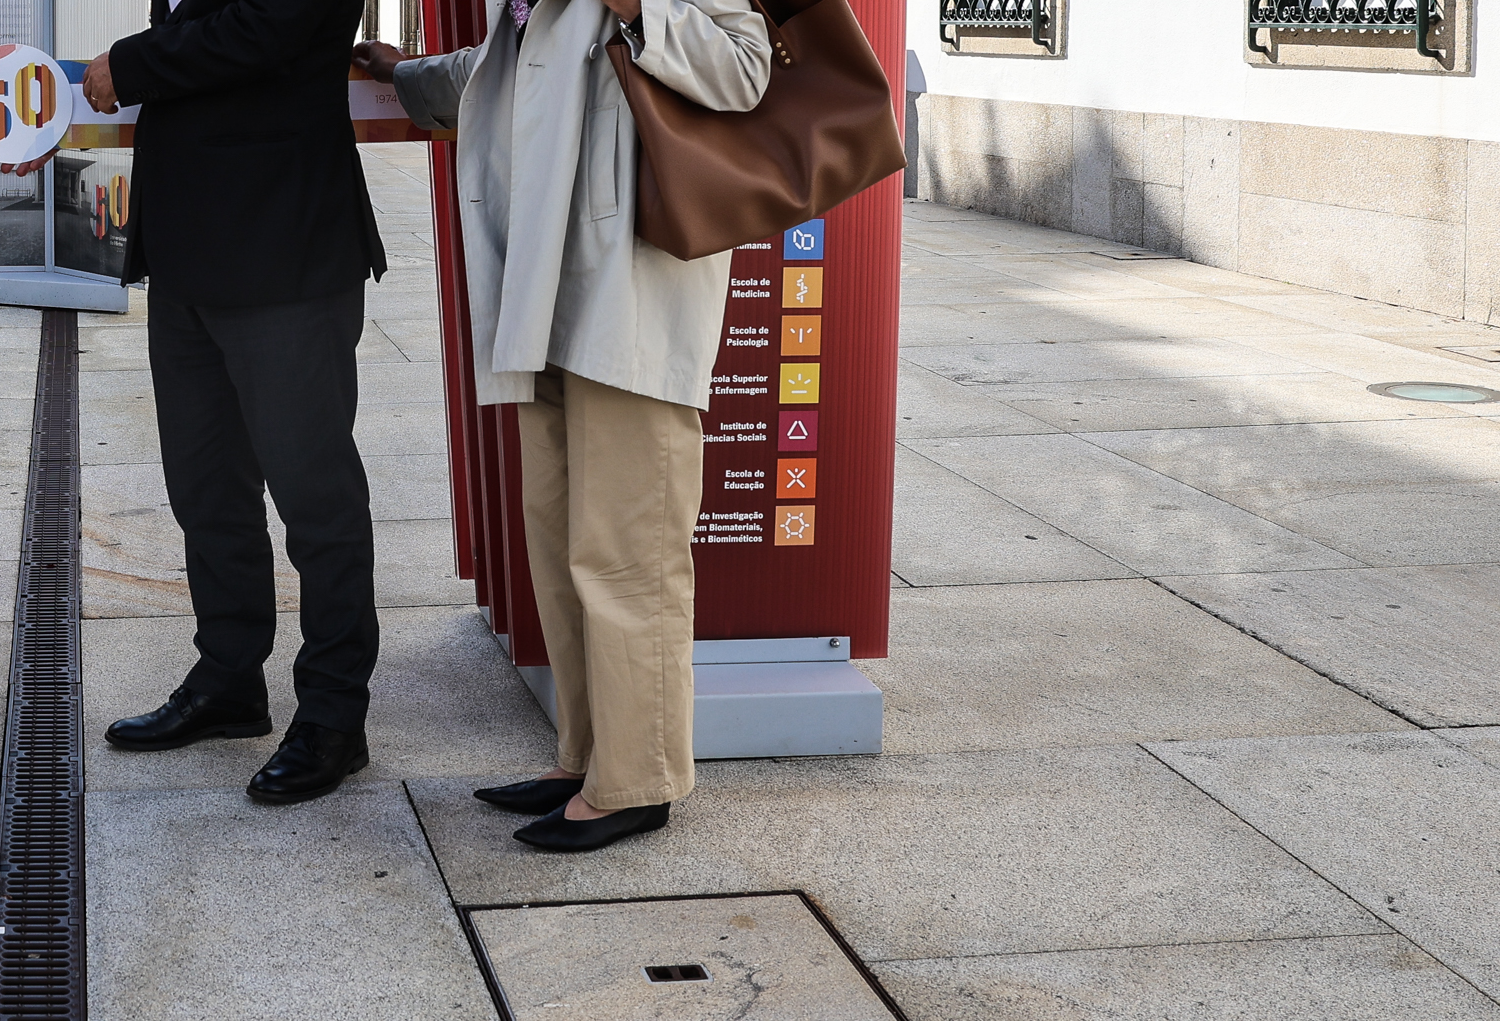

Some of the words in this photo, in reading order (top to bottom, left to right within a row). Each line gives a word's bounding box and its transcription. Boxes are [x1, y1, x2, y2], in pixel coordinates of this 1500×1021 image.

[375, 94, 398, 104] 1974
[730, 278, 758, 286] Escola
[760, 278, 771, 286] de
[732, 290, 770, 298] Medicina
[729, 326, 757, 335] Escola
[758, 326, 769, 335] de
[726, 338, 769, 347] Psicologia
[732, 374, 768, 384] Superior
[715, 386, 768, 395] Enfermagem
[720, 422, 754, 430] Instituto
[756, 422, 767, 430] de
[737, 433, 767, 442] Sociais
[725, 469, 753, 478] Escola
[754, 469, 765, 478] de
[724, 481, 765, 490] Educação
[700, 512, 710, 520] de
[712, 512, 763, 521] Investigação
[709, 523, 763, 532] Biomateriais,
[707, 534, 763, 543] Biomiméticos
